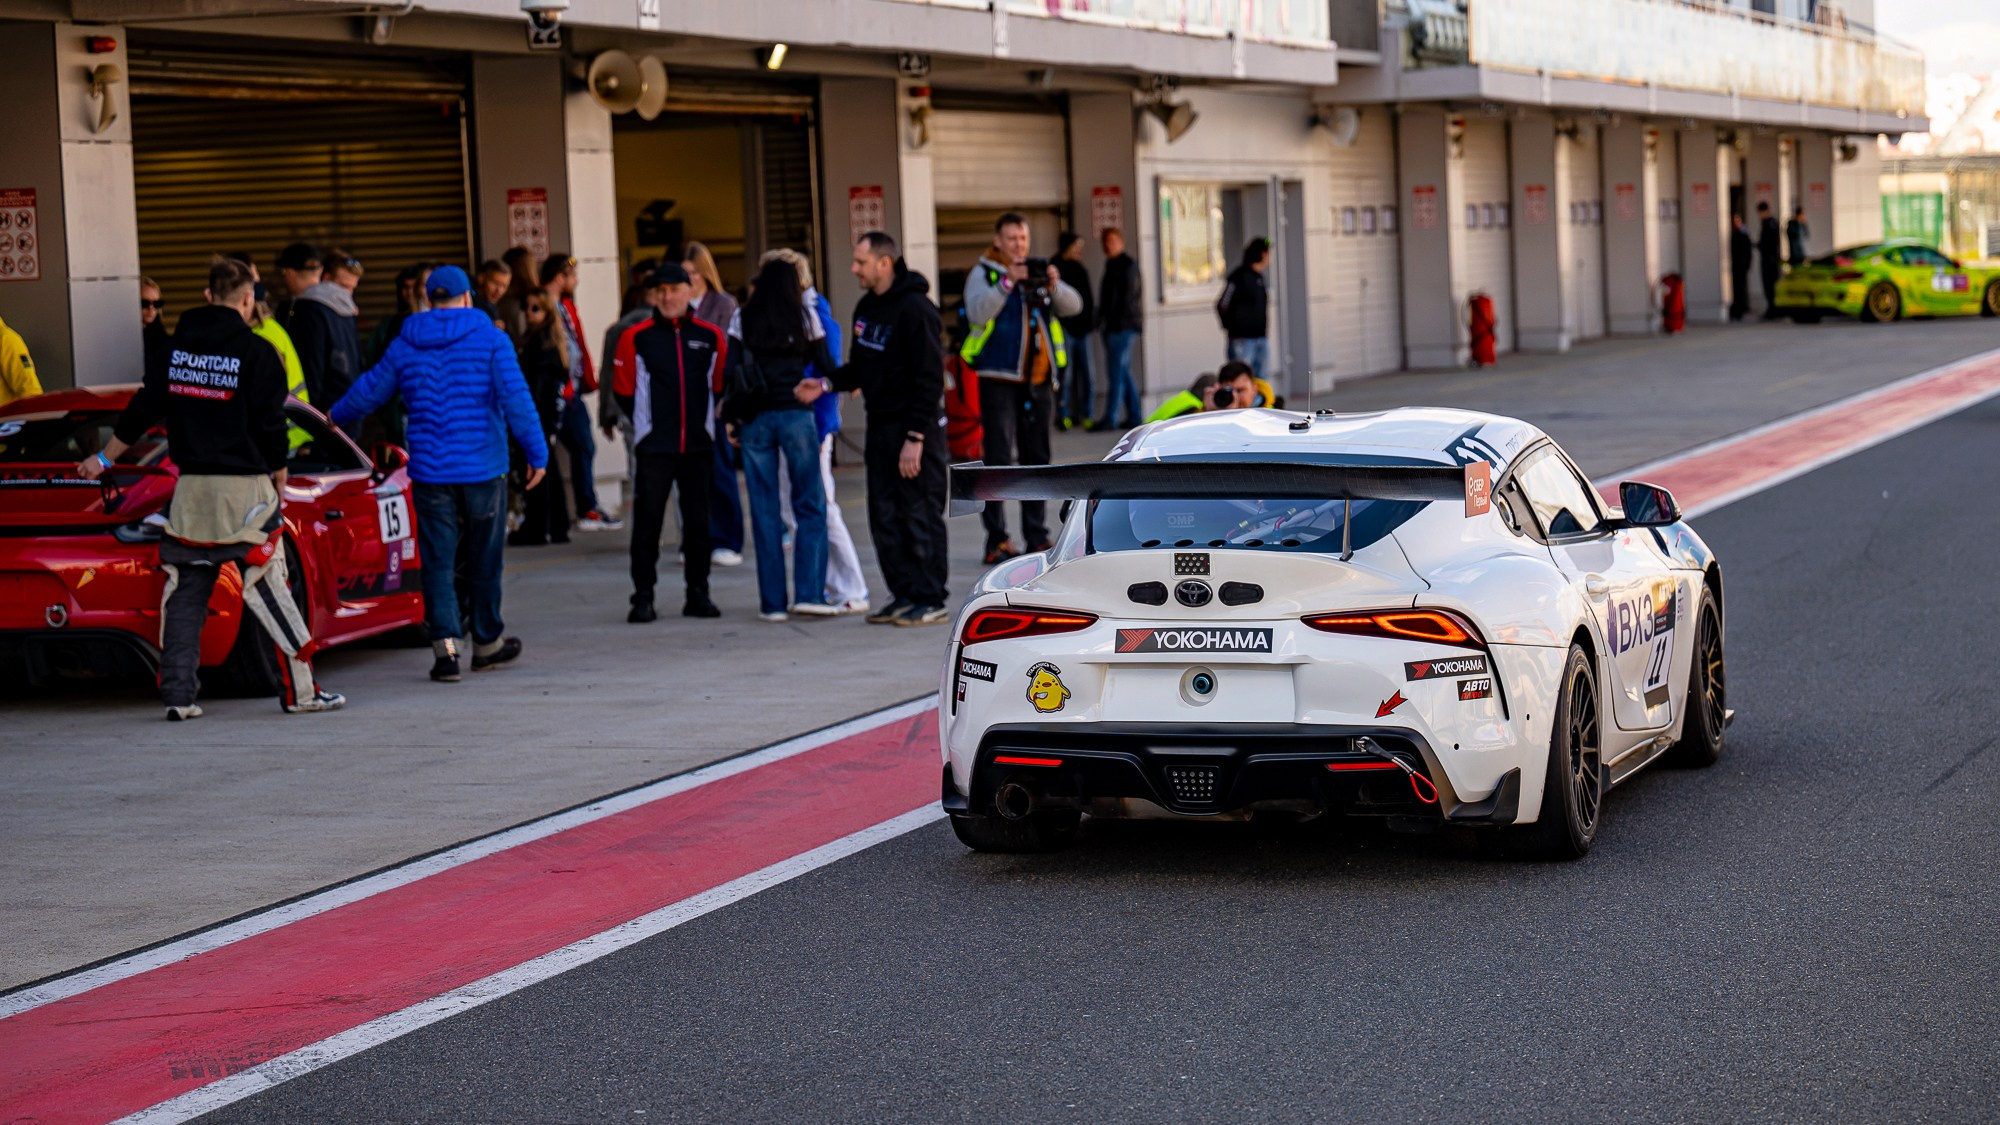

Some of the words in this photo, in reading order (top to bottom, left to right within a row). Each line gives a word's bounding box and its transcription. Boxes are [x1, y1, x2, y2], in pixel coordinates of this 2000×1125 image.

[171, 349, 241, 374] SPORTCAR
[168, 366, 208, 385] RACING
[209, 372, 239, 389] TEAM
[385, 501, 401, 538] 15
[1167, 514, 1195, 525] OMP
[1153, 630, 1269, 649] YOKOHAMA
[1431, 659, 1484, 675] YOKOHAMA
[1647, 636, 1668, 688] 11
[1462, 679, 1490, 693] АВТО
